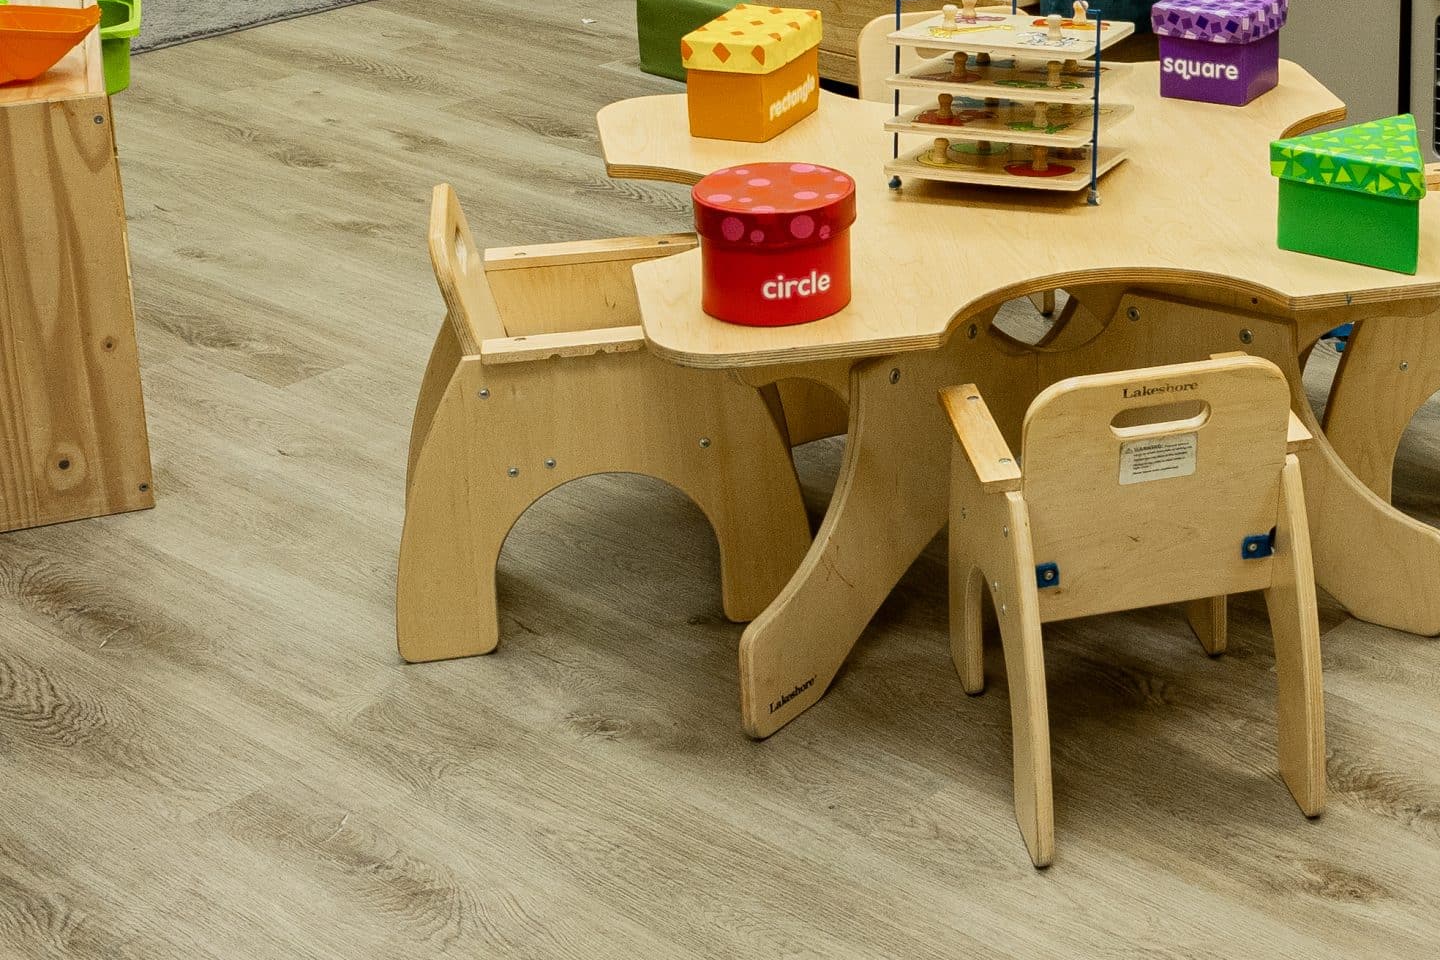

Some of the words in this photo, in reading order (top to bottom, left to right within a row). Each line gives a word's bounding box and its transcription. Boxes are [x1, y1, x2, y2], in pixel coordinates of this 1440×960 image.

[1163, 57, 1239, 80] square
[769, 73, 815, 121] rectangle
[763, 270, 831, 299] circle
[1123, 382, 1199, 399] Lakeshore
[770, 675, 817, 714] Lakeshore
